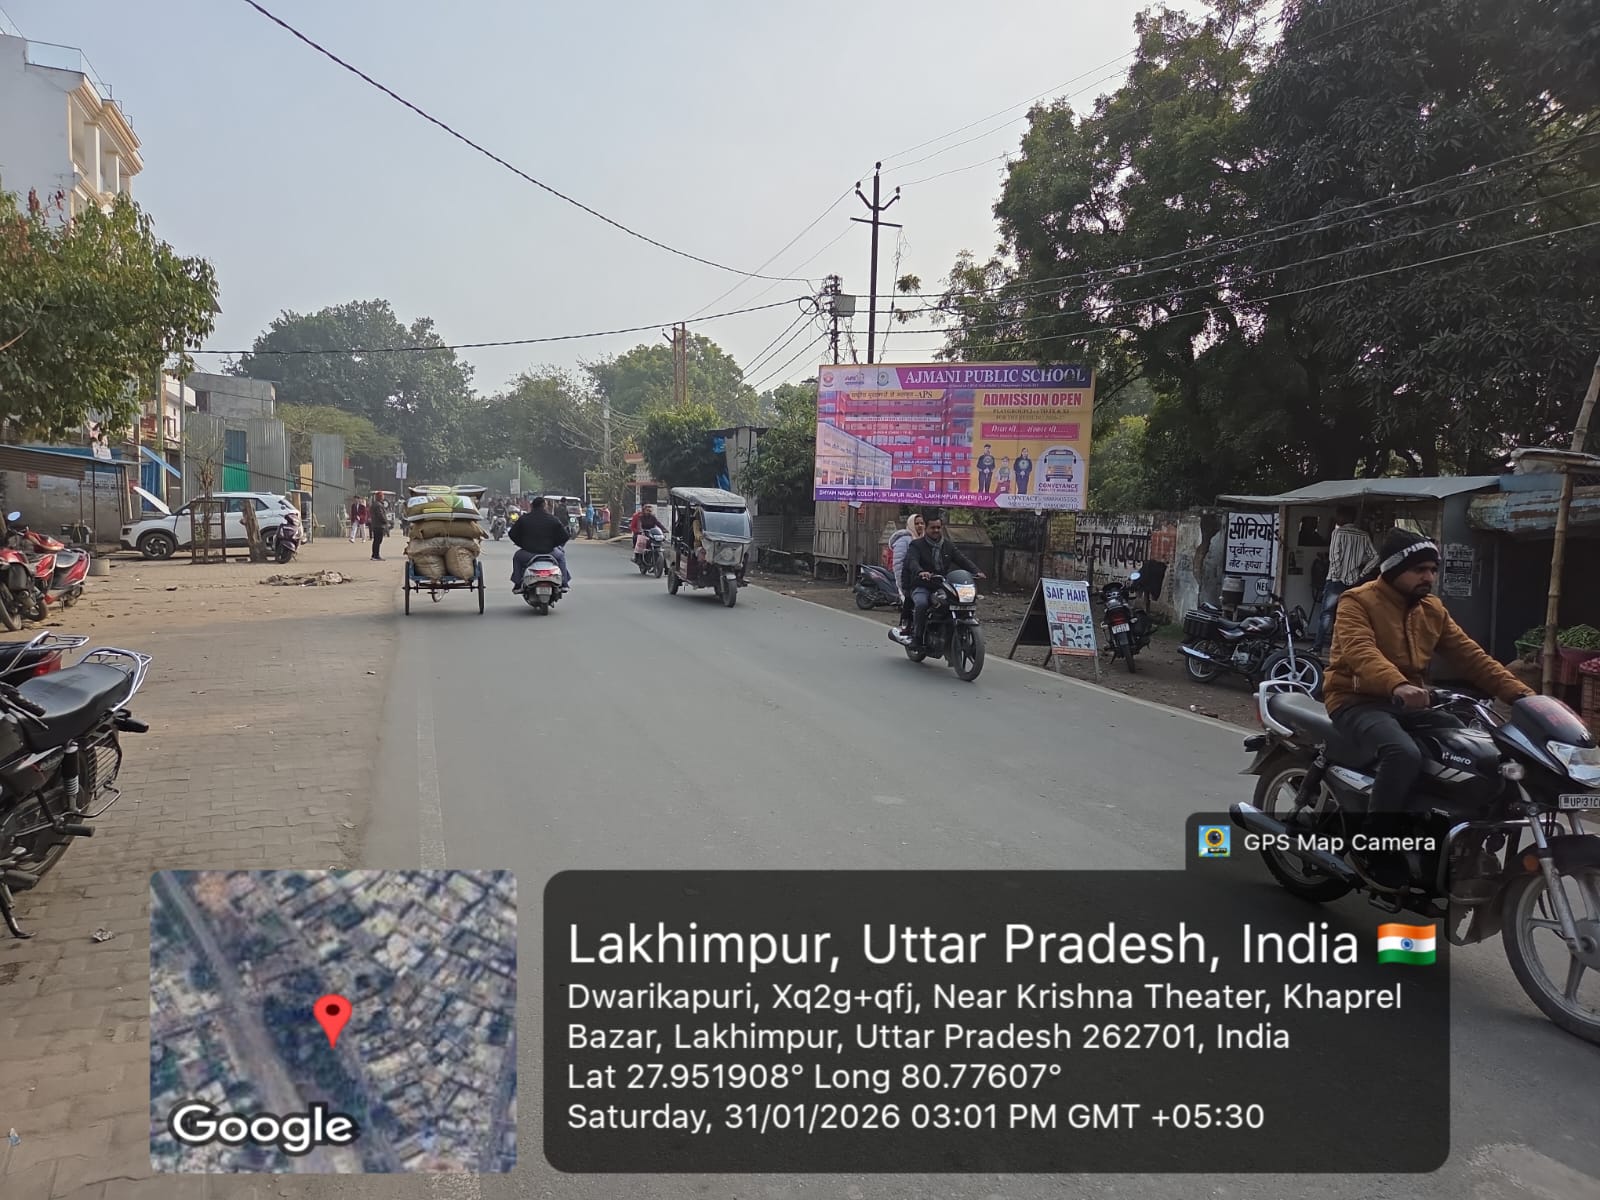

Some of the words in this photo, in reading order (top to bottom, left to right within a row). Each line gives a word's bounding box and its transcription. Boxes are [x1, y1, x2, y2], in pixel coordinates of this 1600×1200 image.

[905, 370, 961, 384] AJMANI
[964, 369, 1019, 383] PUBLIC
[1021, 368, 1086, 383] SCHOOL
[983, 393, 1050, 407] ADMISSION
[1051, 393, 1083, 407] OPEN
[978, 494, 992, 502] (UP)
[1046, 586, 1065, 600] SAIF
[1066, 589, 1088, 602] HAIR
[1450, 754, 1472, 766] Hero
[1570, 797, 1600, 808] UP31C
